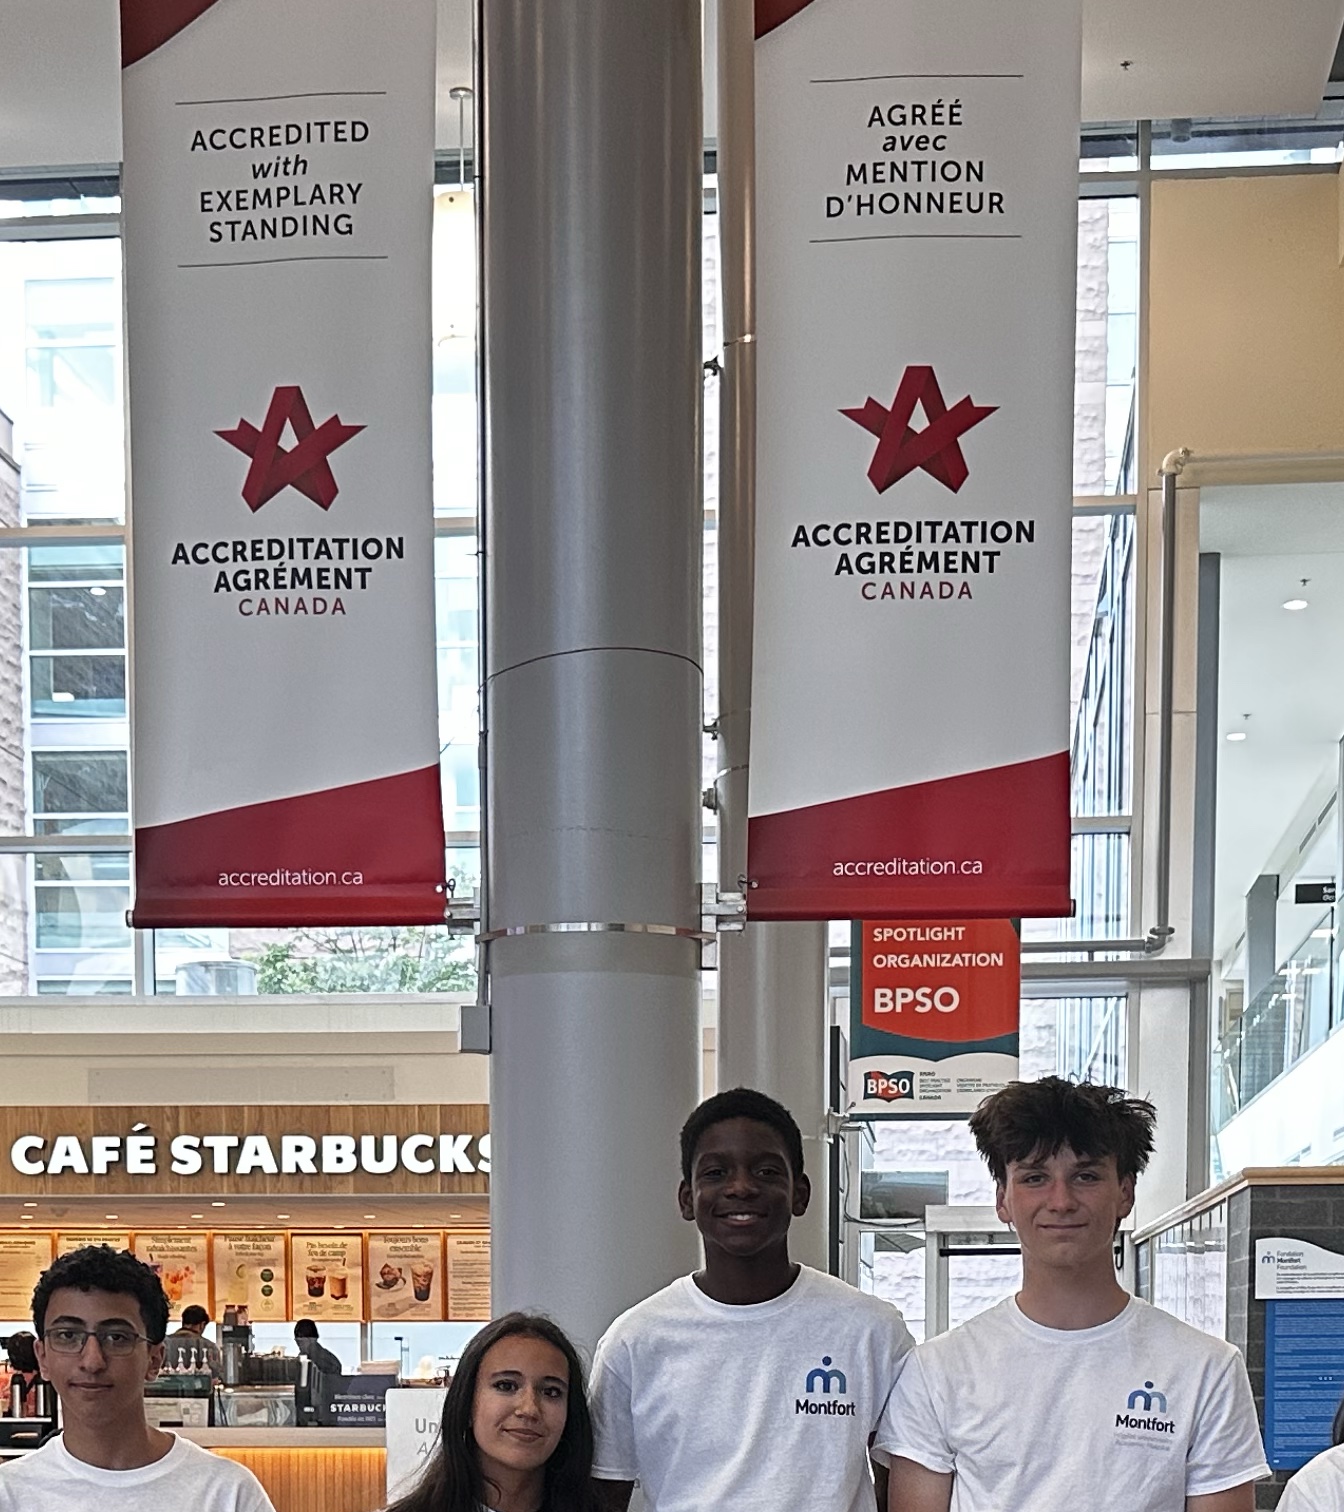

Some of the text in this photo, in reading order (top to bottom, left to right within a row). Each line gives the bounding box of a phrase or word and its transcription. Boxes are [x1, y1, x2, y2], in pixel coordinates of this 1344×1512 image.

[867, 98, 964, 128] AGRÉÉ
[190, 120, 370, 152] ACCREDITED
[882, 134, 948, 153] avec
[251, 154, 309, 180] with
[846, 160, 984, 186] MENTION
[200, 182, 363, 213] EXEMPLARY
[826, 191, 1005, 218] D'HONNEUR
[209, 213, 354, 243] STANDING
[791, 520, 1036, 548] ACCREDITATION
[171, 536, 405, 565] ACCREDITATION
[834, 545, 1002, 576] AGRÉMENT
[214, 561, 373, 593] AGRÉMENT
[861, 581, 974, 601] CANADA
[238, 596, 347, 617] CANADA
[218, 867, 364, 887] accreditation.ca
[832, 857, 984, 876] accreditation.ca
[872, 926, 966, 942] SPOTLIGHT
[872, 952, 1004, 969] ORGANIZATION
[873, 985, 961, 1014] BPSO
[867, 1077, 910, 1095] BPSO
[10, 1122, 157, 1175] CAFÉ
[795, 1398, 856, 1417] Montfort
[1115, 1413, 1176, 1434] Montfort
